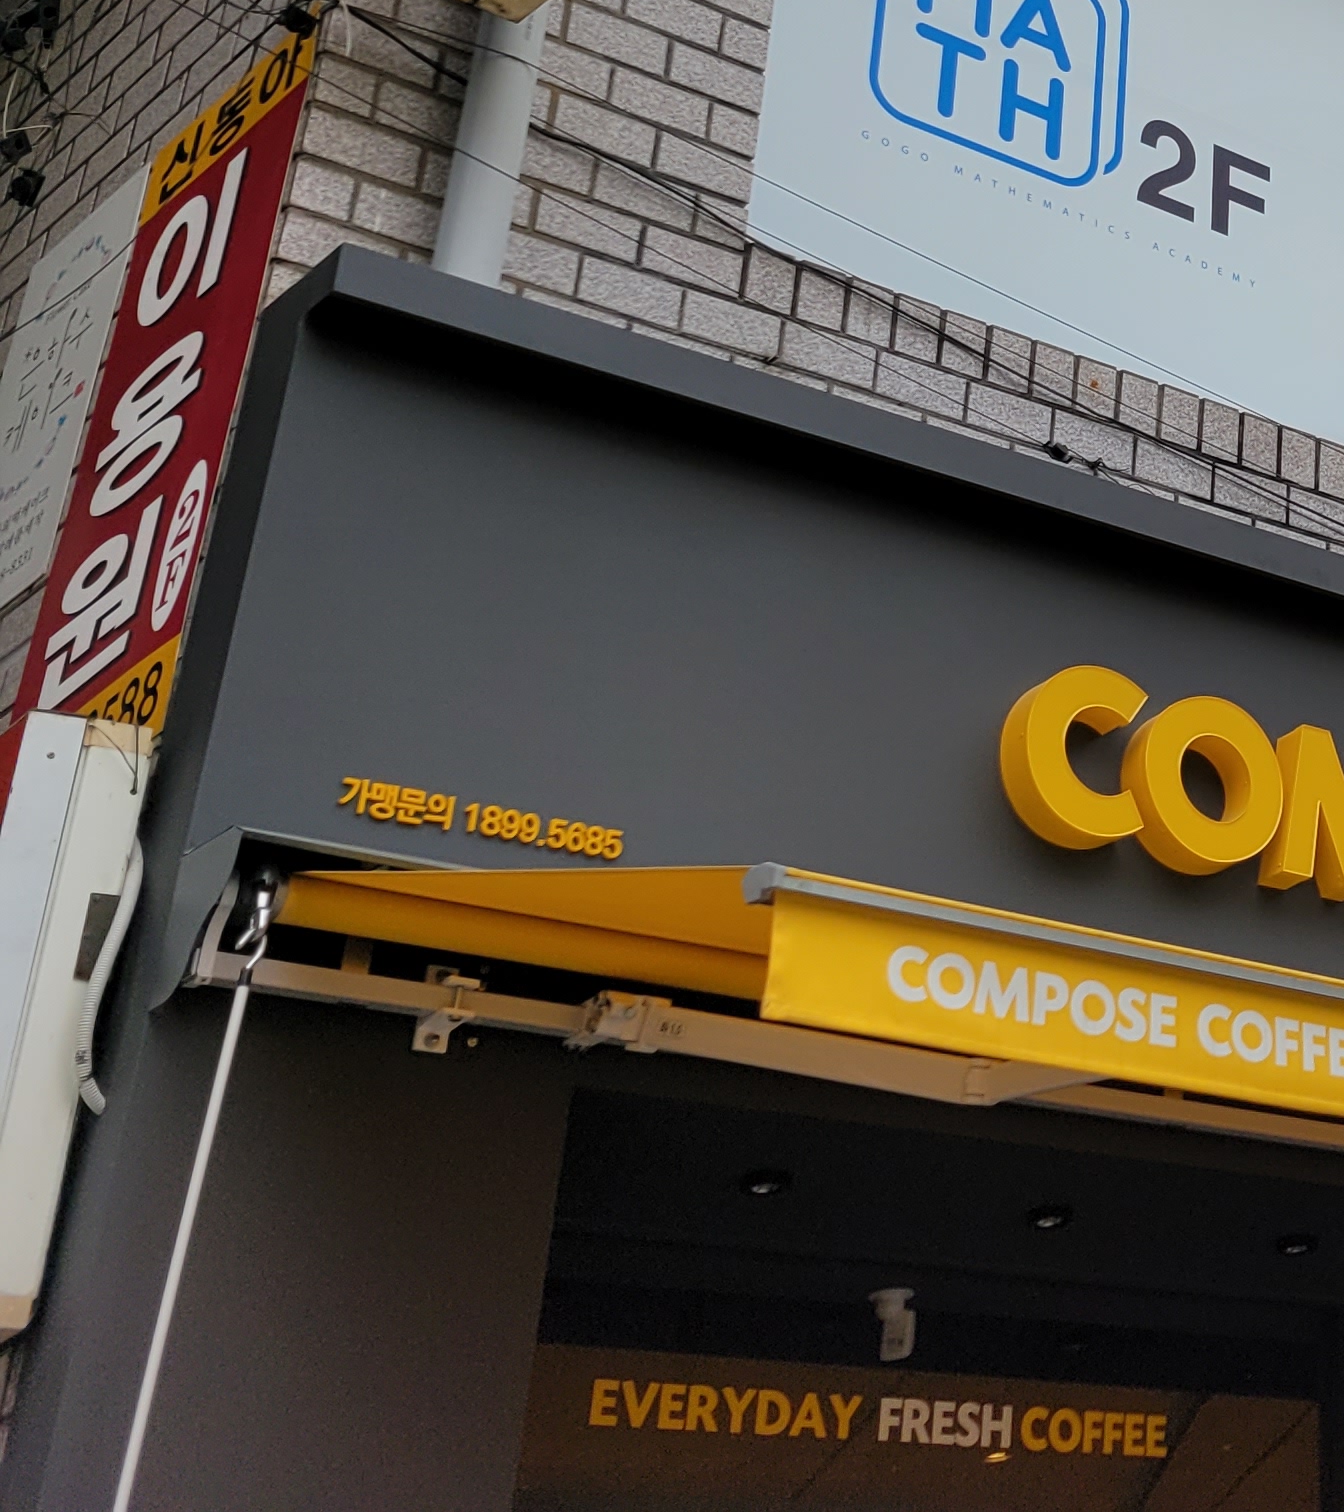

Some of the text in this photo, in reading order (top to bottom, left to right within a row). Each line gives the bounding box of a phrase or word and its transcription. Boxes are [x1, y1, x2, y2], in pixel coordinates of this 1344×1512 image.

[158, 35, 305, 200] 신동아
[861, 128, 1259, 289] GOGO MATHEMATICS ACADEMY
[1136, 119, 1272, 237] 2F
[39, 147, 250, 708] 이용원
[154, 492, 202, 615] 2F
[338, 776, 624, 860] 가맹문의 1899.5685
[887, 945, 1178, 1048] COMPOSE
[588, 1377, 1169, 1460] EVERYDAY FRESH COFFEE
